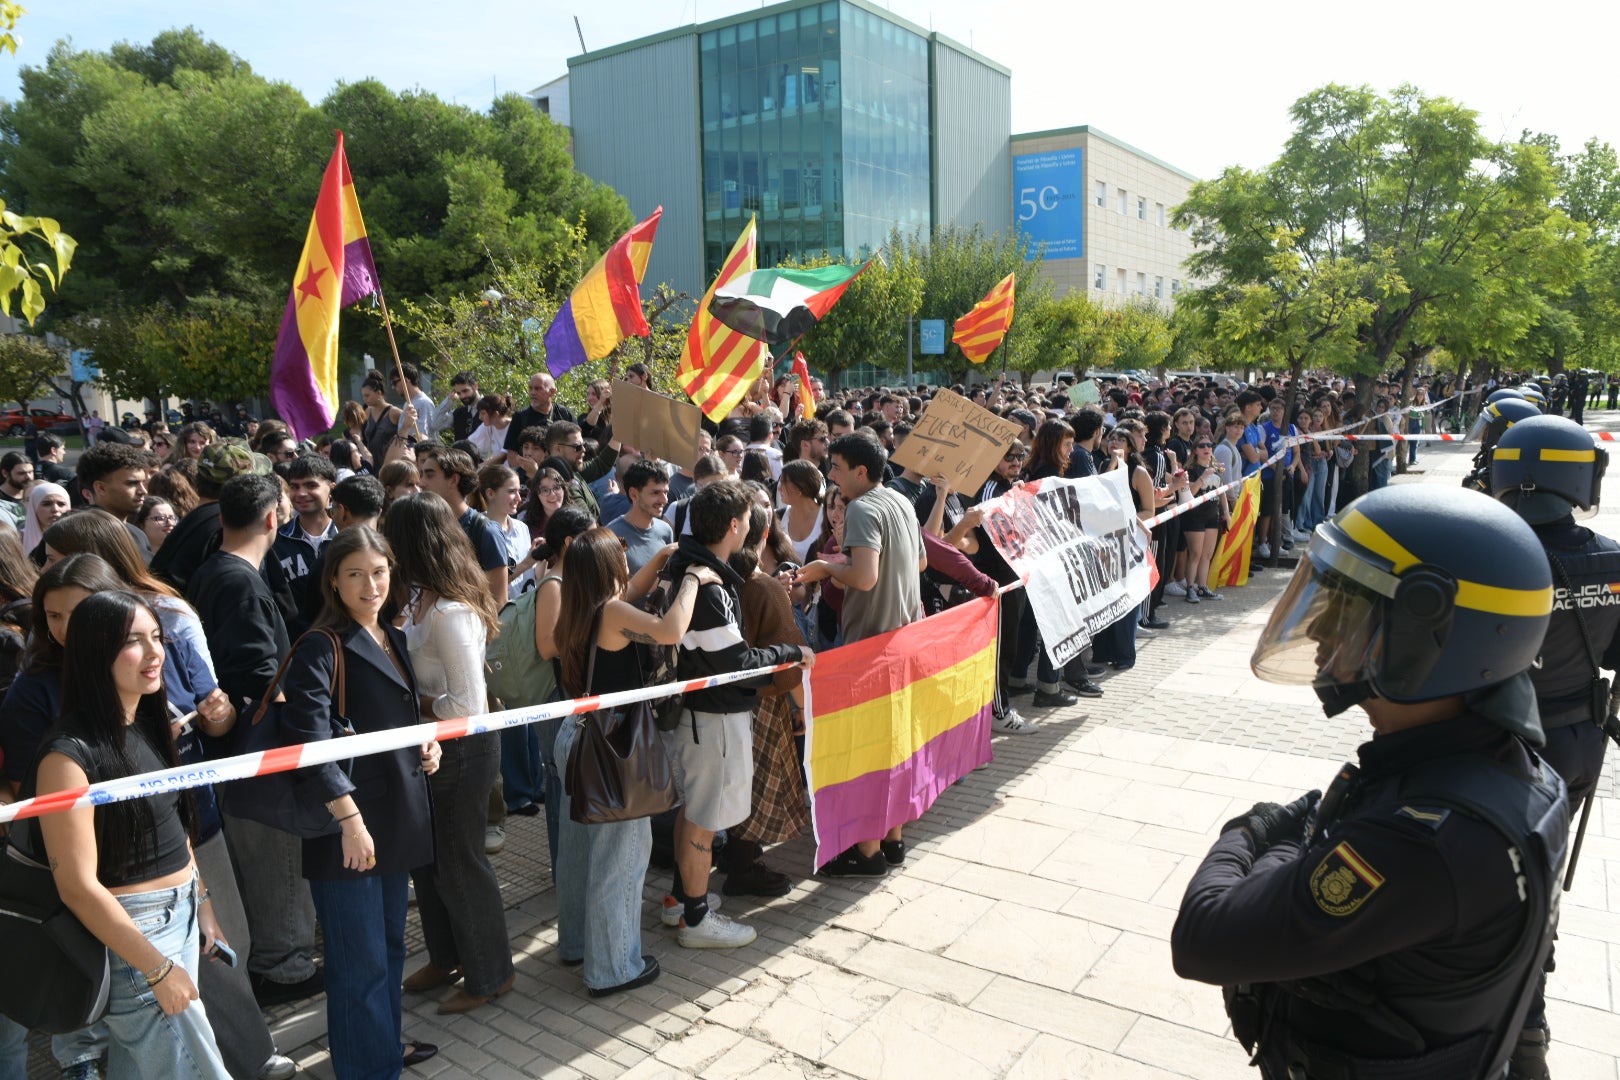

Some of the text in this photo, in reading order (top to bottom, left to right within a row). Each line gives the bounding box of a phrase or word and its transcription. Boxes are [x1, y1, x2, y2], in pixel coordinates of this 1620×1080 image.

[917, 415, 967, 441] FUERA
[917, 446, 973, 478] DE LA UA
[281, 553, 309, 582] TA
